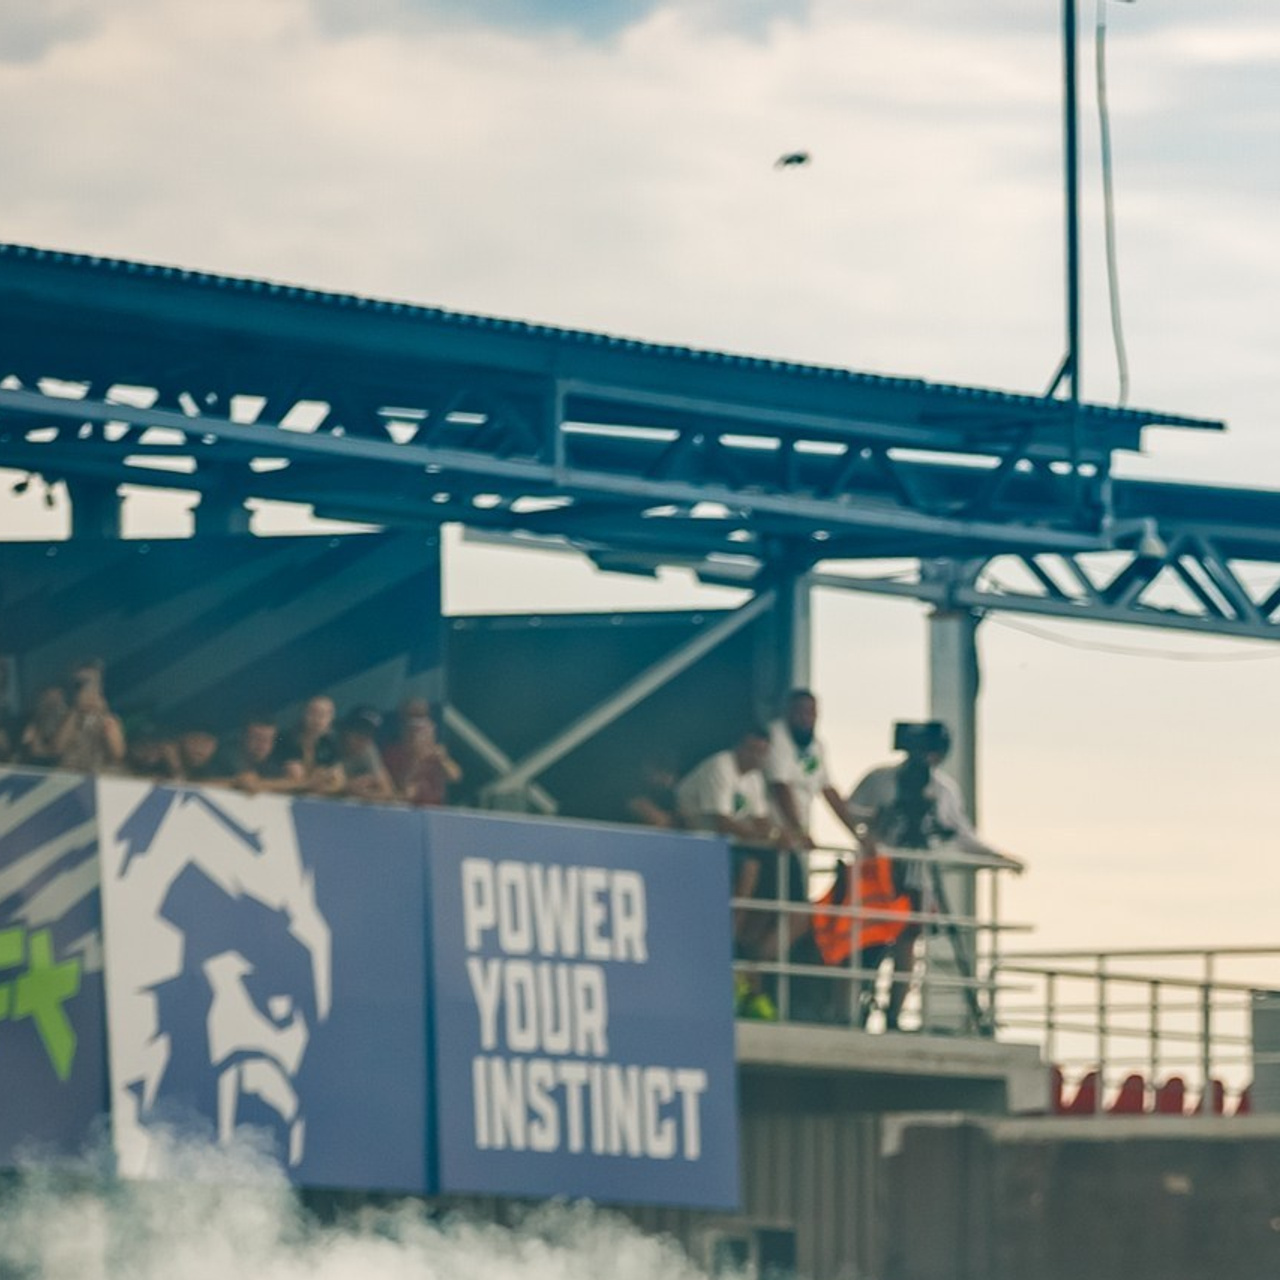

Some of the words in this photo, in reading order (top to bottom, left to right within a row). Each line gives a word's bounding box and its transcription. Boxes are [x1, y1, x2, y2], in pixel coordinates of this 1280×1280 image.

[461, 858, 648, 964] POWER
[466, 957, 609, 1057] YOUR
[472, 1056, 708, 1161] INSTINCT
